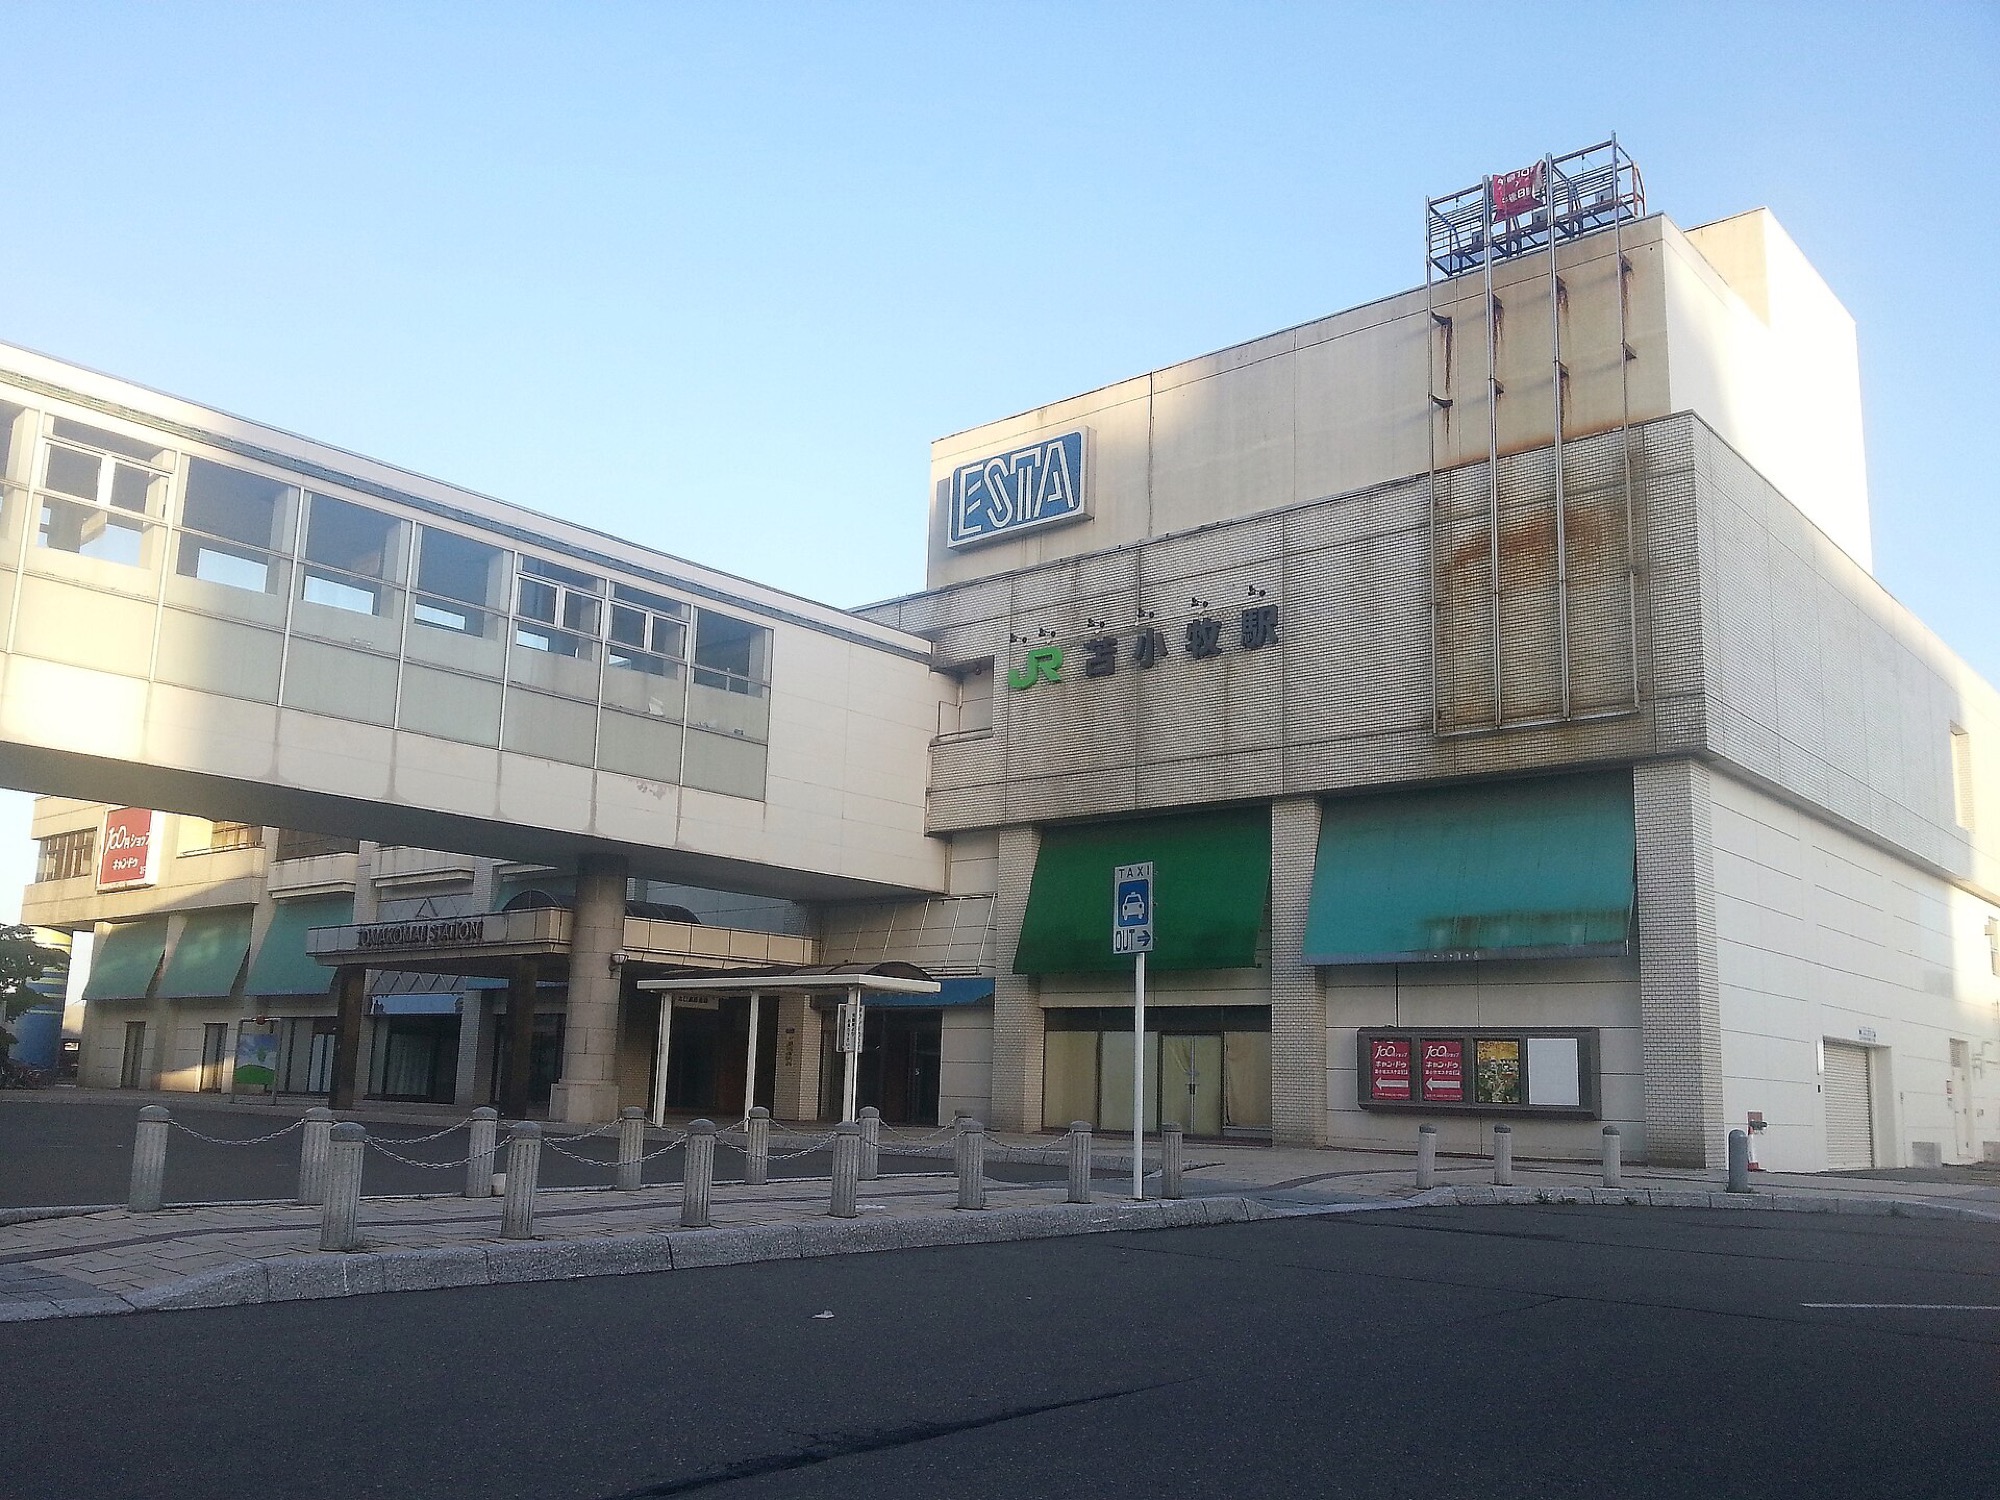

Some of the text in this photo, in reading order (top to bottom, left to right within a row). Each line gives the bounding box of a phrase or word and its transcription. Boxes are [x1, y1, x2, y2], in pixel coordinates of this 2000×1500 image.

[958, 441, 1075, 537] ESTA
[1008, 604, 1279, 689] JR 苫小牧駅
[1119, 866, 1149, 878] TAXI
[357, 920, 484, 946] TOMAKOMAI STATION
[1116, 929, 1135, 951] OUT
